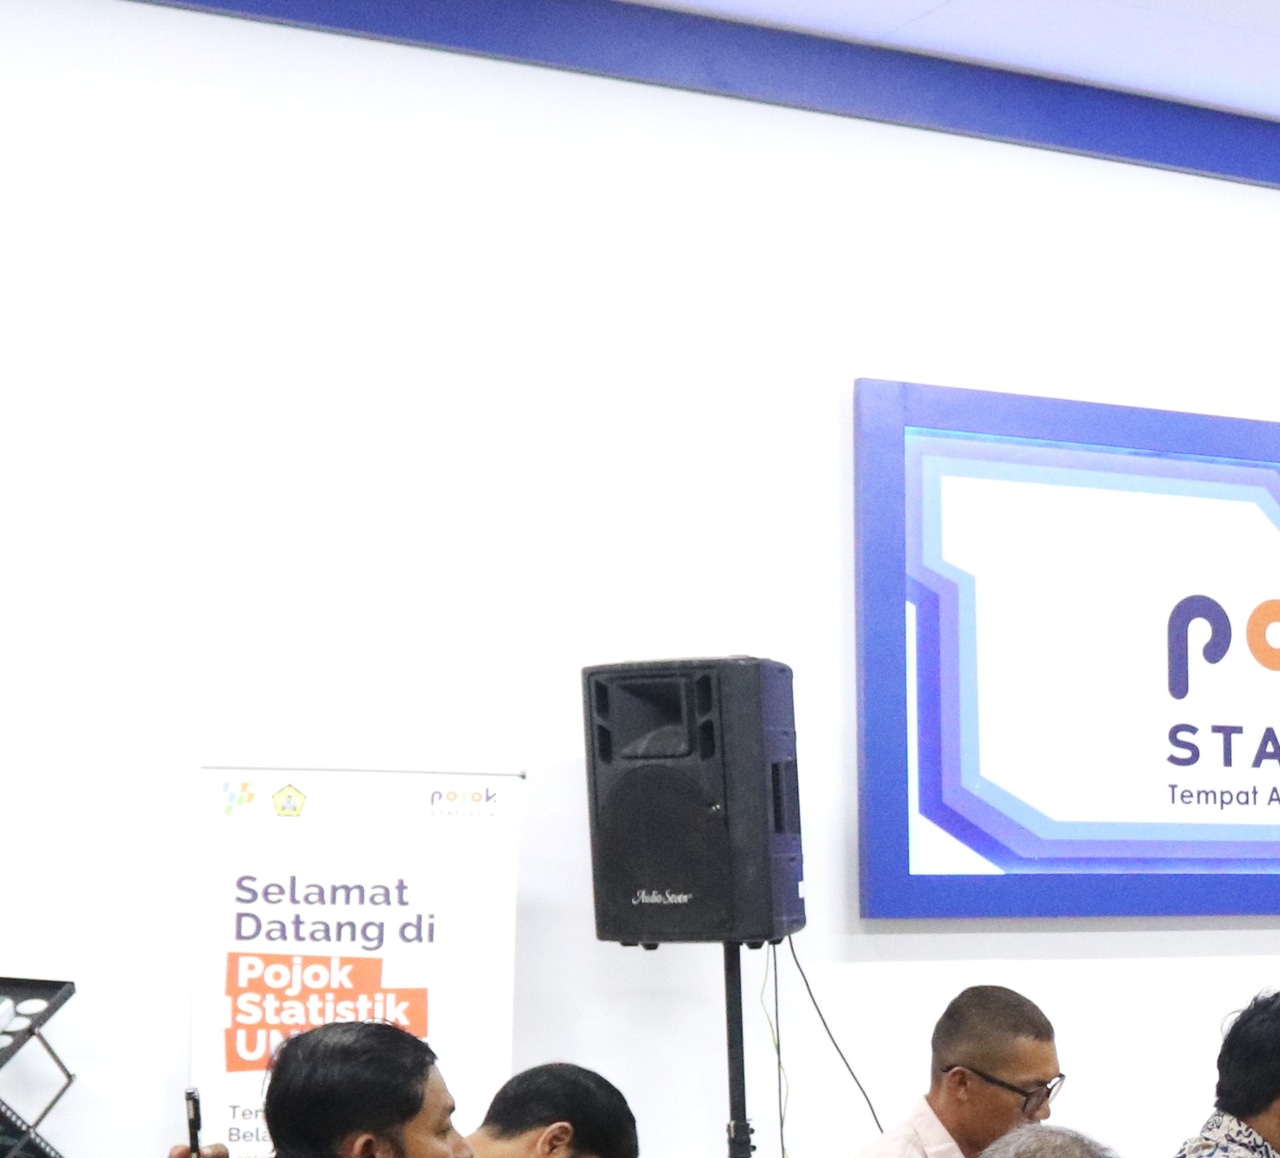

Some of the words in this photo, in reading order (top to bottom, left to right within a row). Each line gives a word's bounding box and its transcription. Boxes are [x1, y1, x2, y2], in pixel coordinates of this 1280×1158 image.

[1168, 784, 1258, 810] Tempat
[235, 875, 409, 906] Selamat
[235, 912, 384, 951] Datang
[399, 914, 435, 943] di
[237, 956, 354, 996] Pojok
[236, 992, 410, 1025] Statistik
